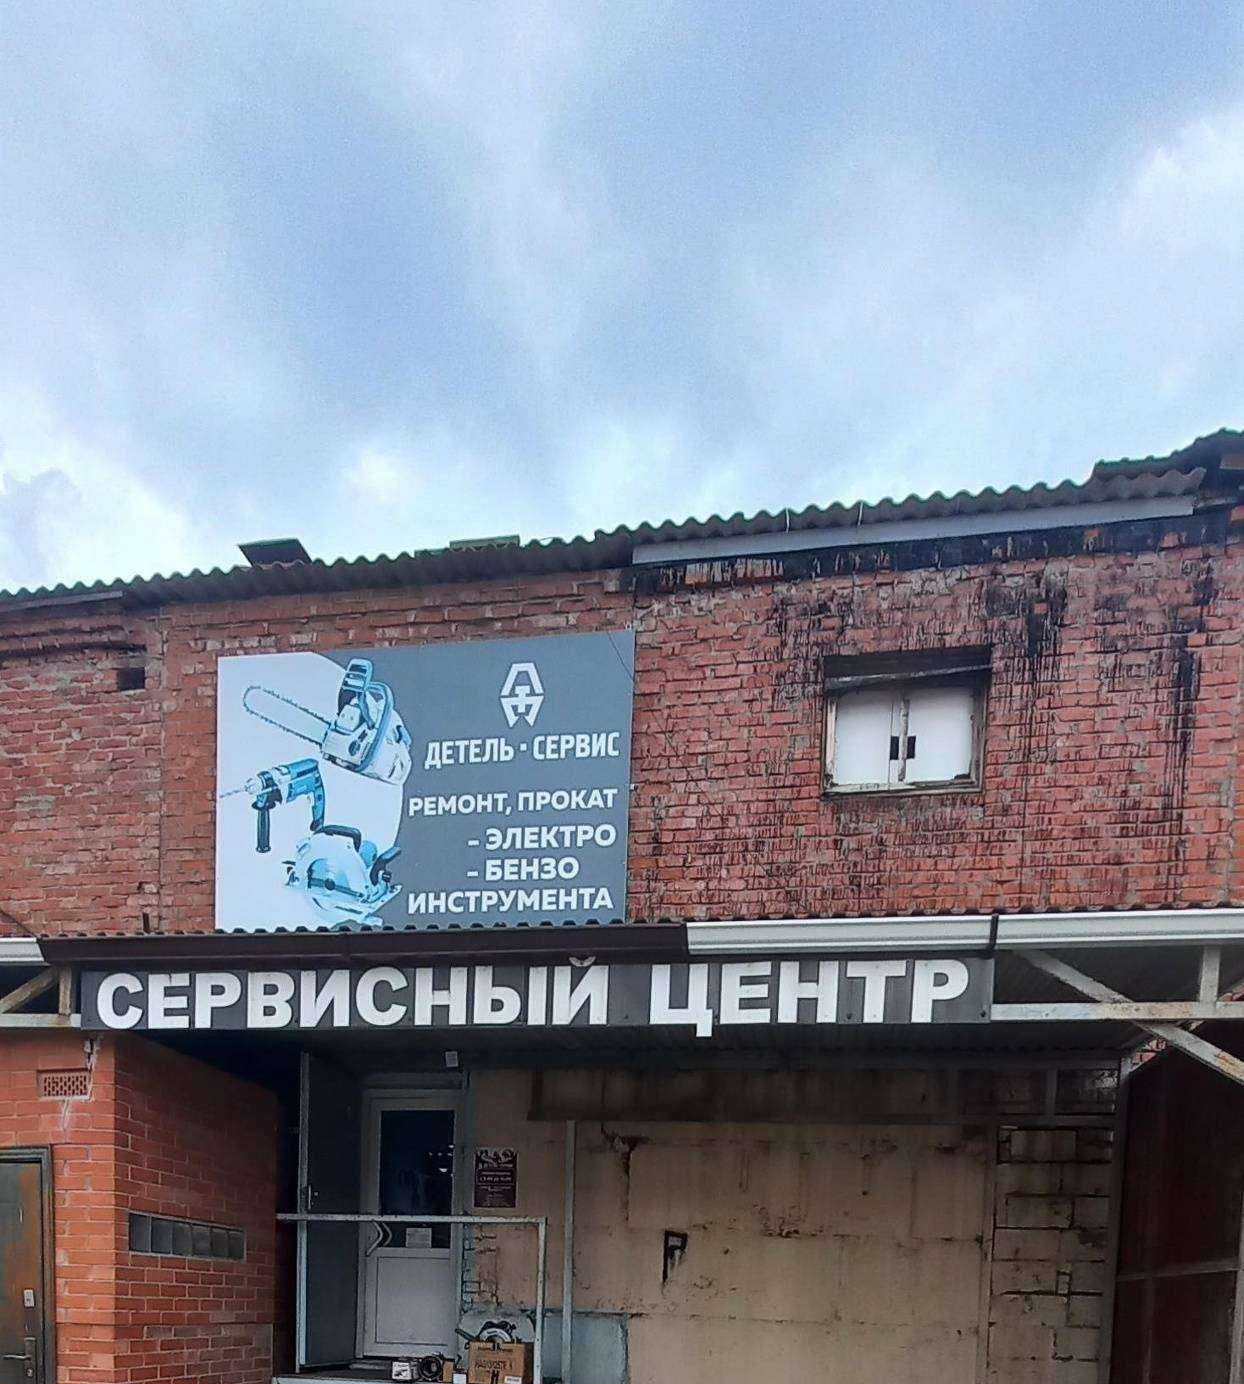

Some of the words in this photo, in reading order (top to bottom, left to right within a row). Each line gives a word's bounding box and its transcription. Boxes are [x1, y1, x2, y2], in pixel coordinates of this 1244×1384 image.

[424, 737, 515, 770] ДЕТЕЛЬ
[532, 731, 621, 761] СЕРВИС
[408, 792, 512, 817] РЕМОНТ,
[517, 788, 618, 812] ПРОКАТ
[485, 823, 617, 851] ЭЛЕКТРО
[485, 856, 580, 882] БЕНЗО
[407, 886, 614, 915] ИНСТРУМЕНТА
[96, 956, 609, 1030] СЕРВИСНЫЙ
[649, 959, 970, 1037] ЦЕНТР
